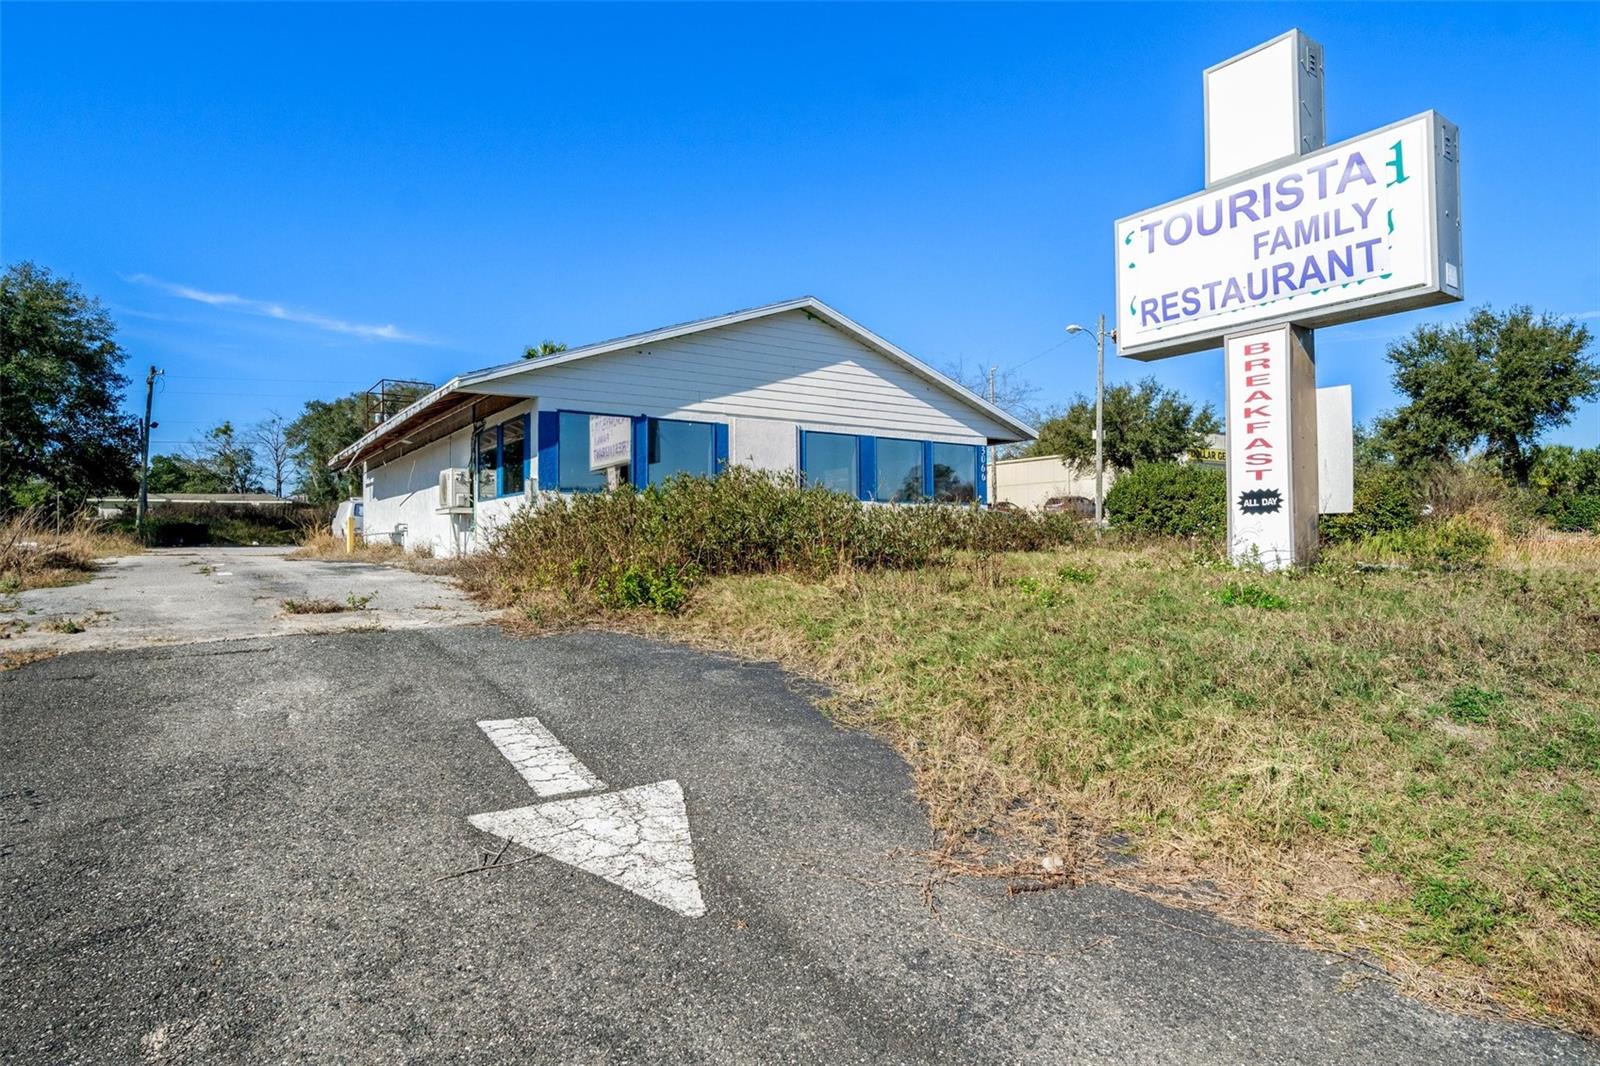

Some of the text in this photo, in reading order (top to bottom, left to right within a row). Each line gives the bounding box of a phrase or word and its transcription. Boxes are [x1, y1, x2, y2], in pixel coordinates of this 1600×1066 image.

[1140, 151, 1377, 254] TOURISTA
[1253, 197, 1378, 260] FAMILY
[1140, 237, 1382, 327] RESTAURANT
[1243, 342, 1273, 481] BREAKFAST
[1243, 497, 1278, 507] ALL DAY
